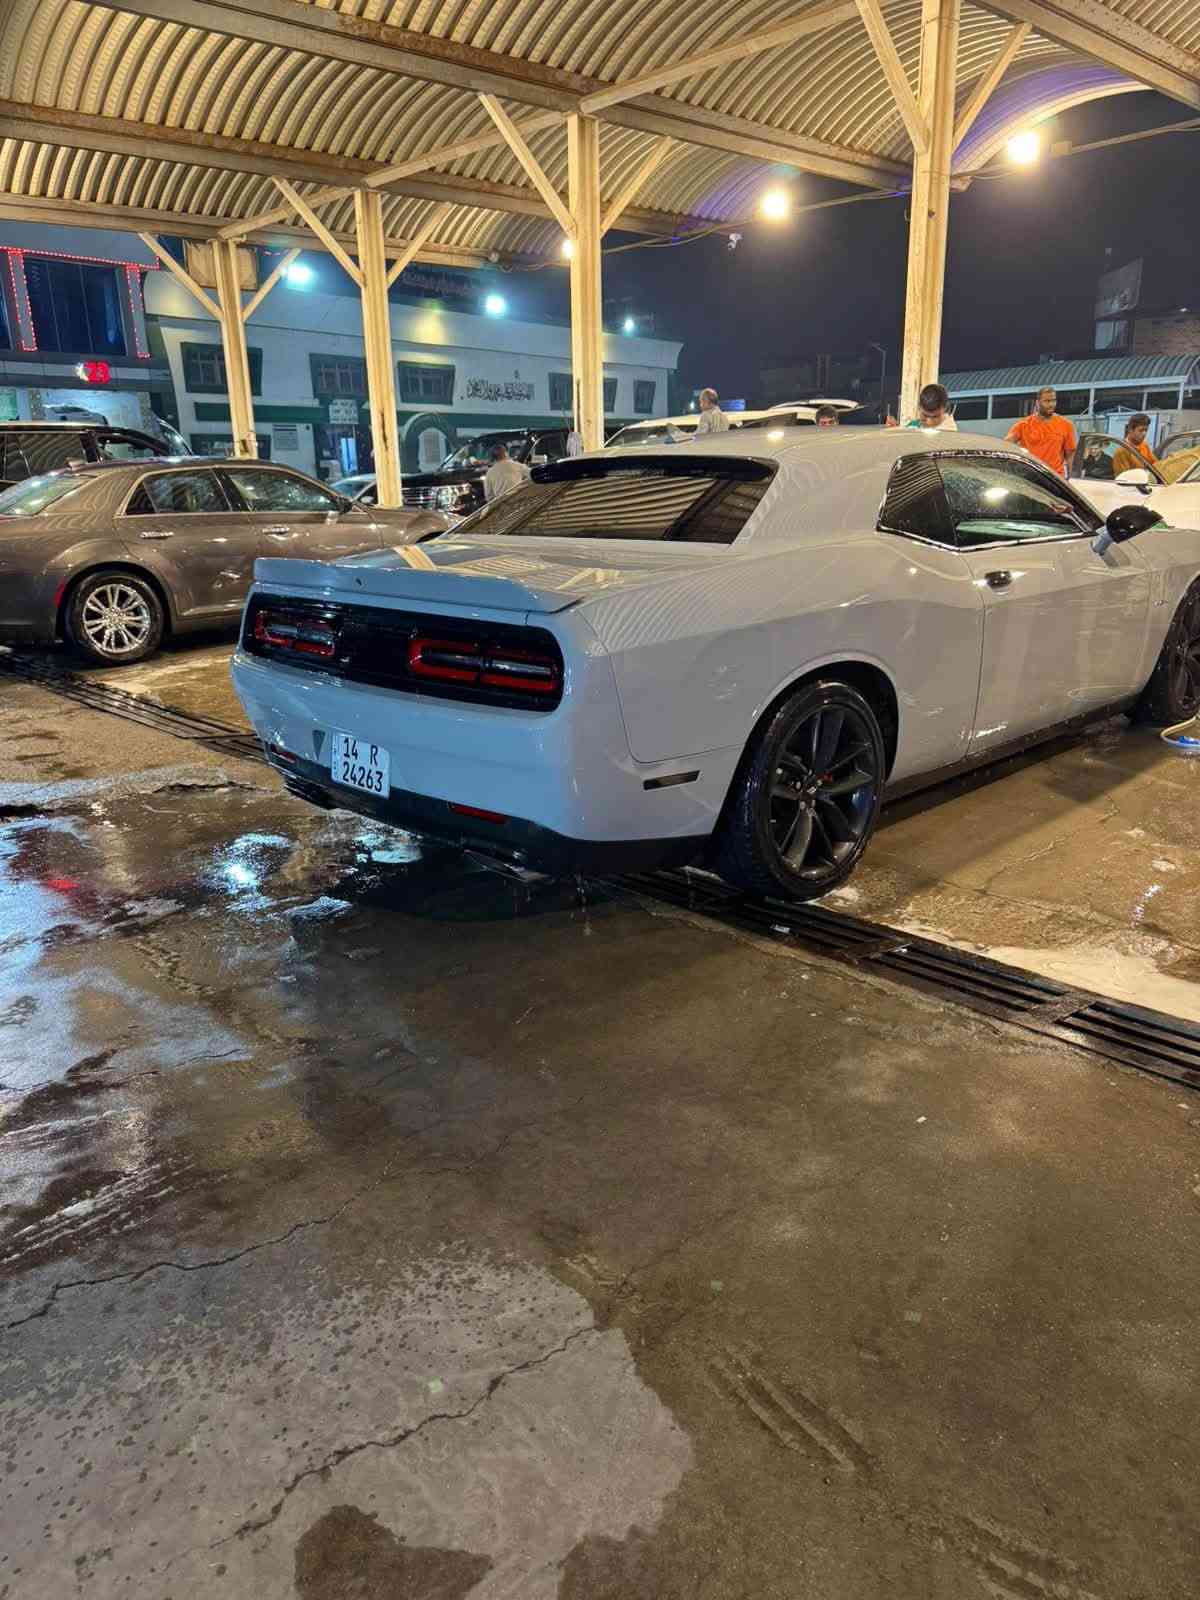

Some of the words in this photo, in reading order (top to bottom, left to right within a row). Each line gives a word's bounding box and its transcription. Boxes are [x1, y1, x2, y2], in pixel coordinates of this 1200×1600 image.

[343, 737, 358, 760] 14
[370, 744, 378, 767] R
[343, 761, 383, 792] 24263
